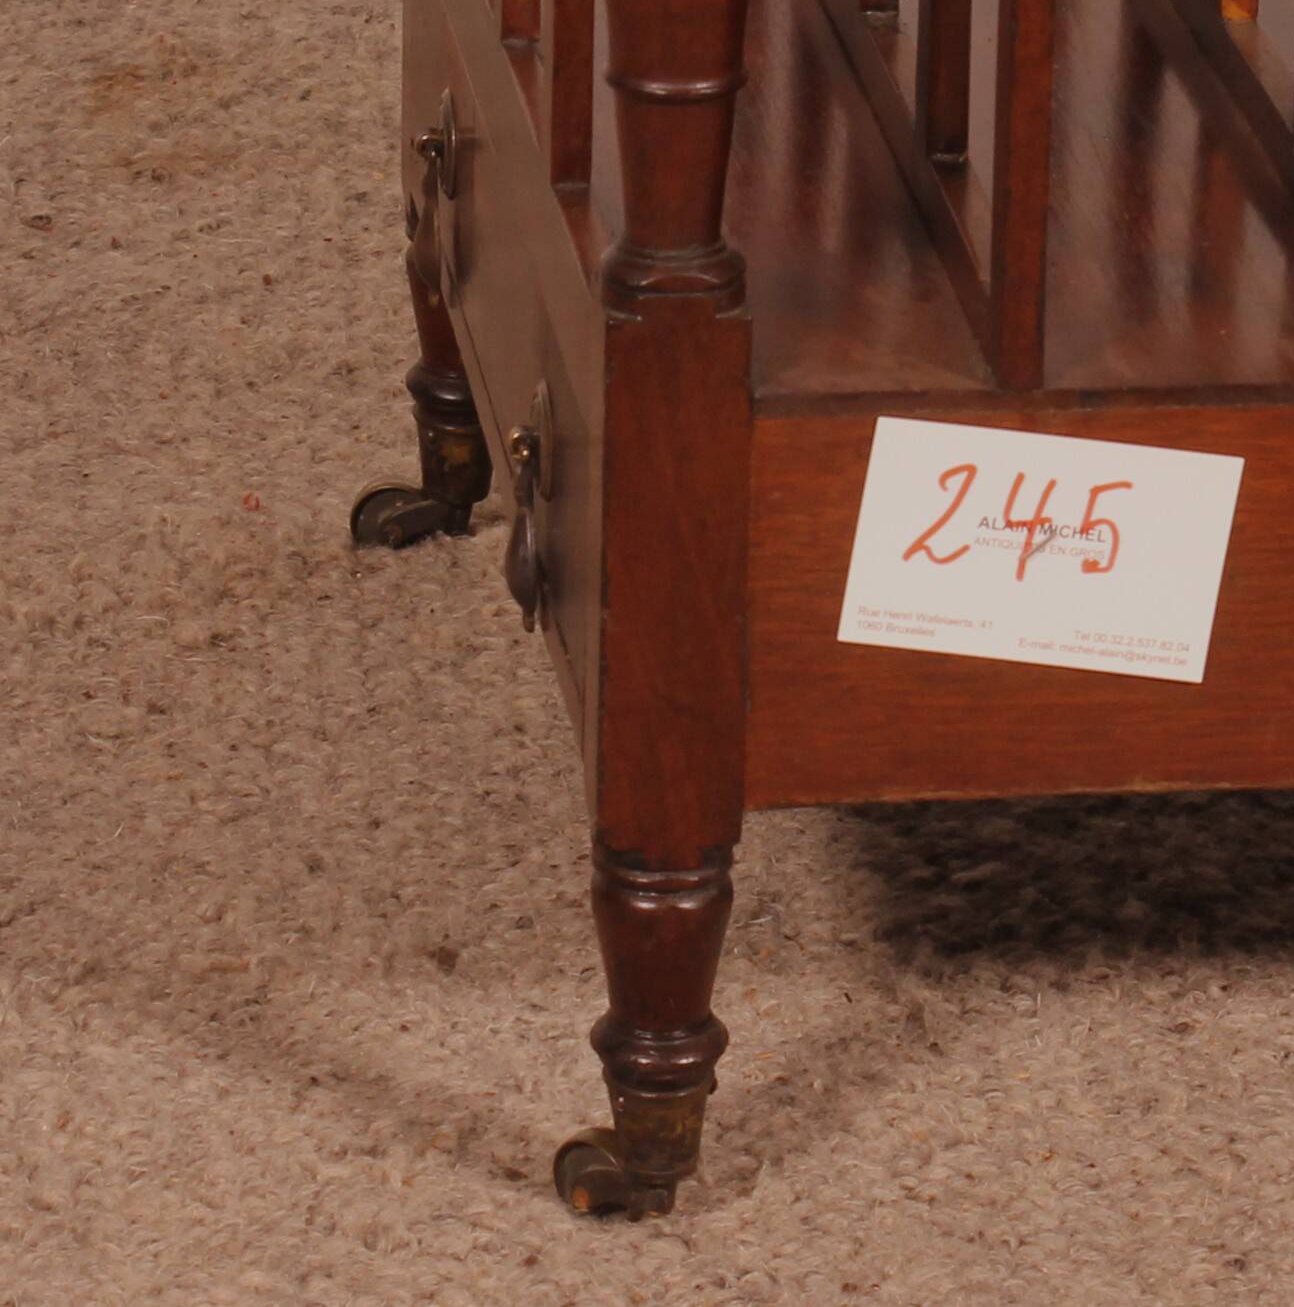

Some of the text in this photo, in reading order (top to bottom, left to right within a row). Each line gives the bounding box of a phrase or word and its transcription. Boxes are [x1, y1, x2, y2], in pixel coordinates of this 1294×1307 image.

[902, 463, 1134, 581] 245
[978, 516, 1107, 544] ALAIN MICHEL
[857, 604, 880, 618] Rue
[885, 622, 936, 638] Bruxelles
